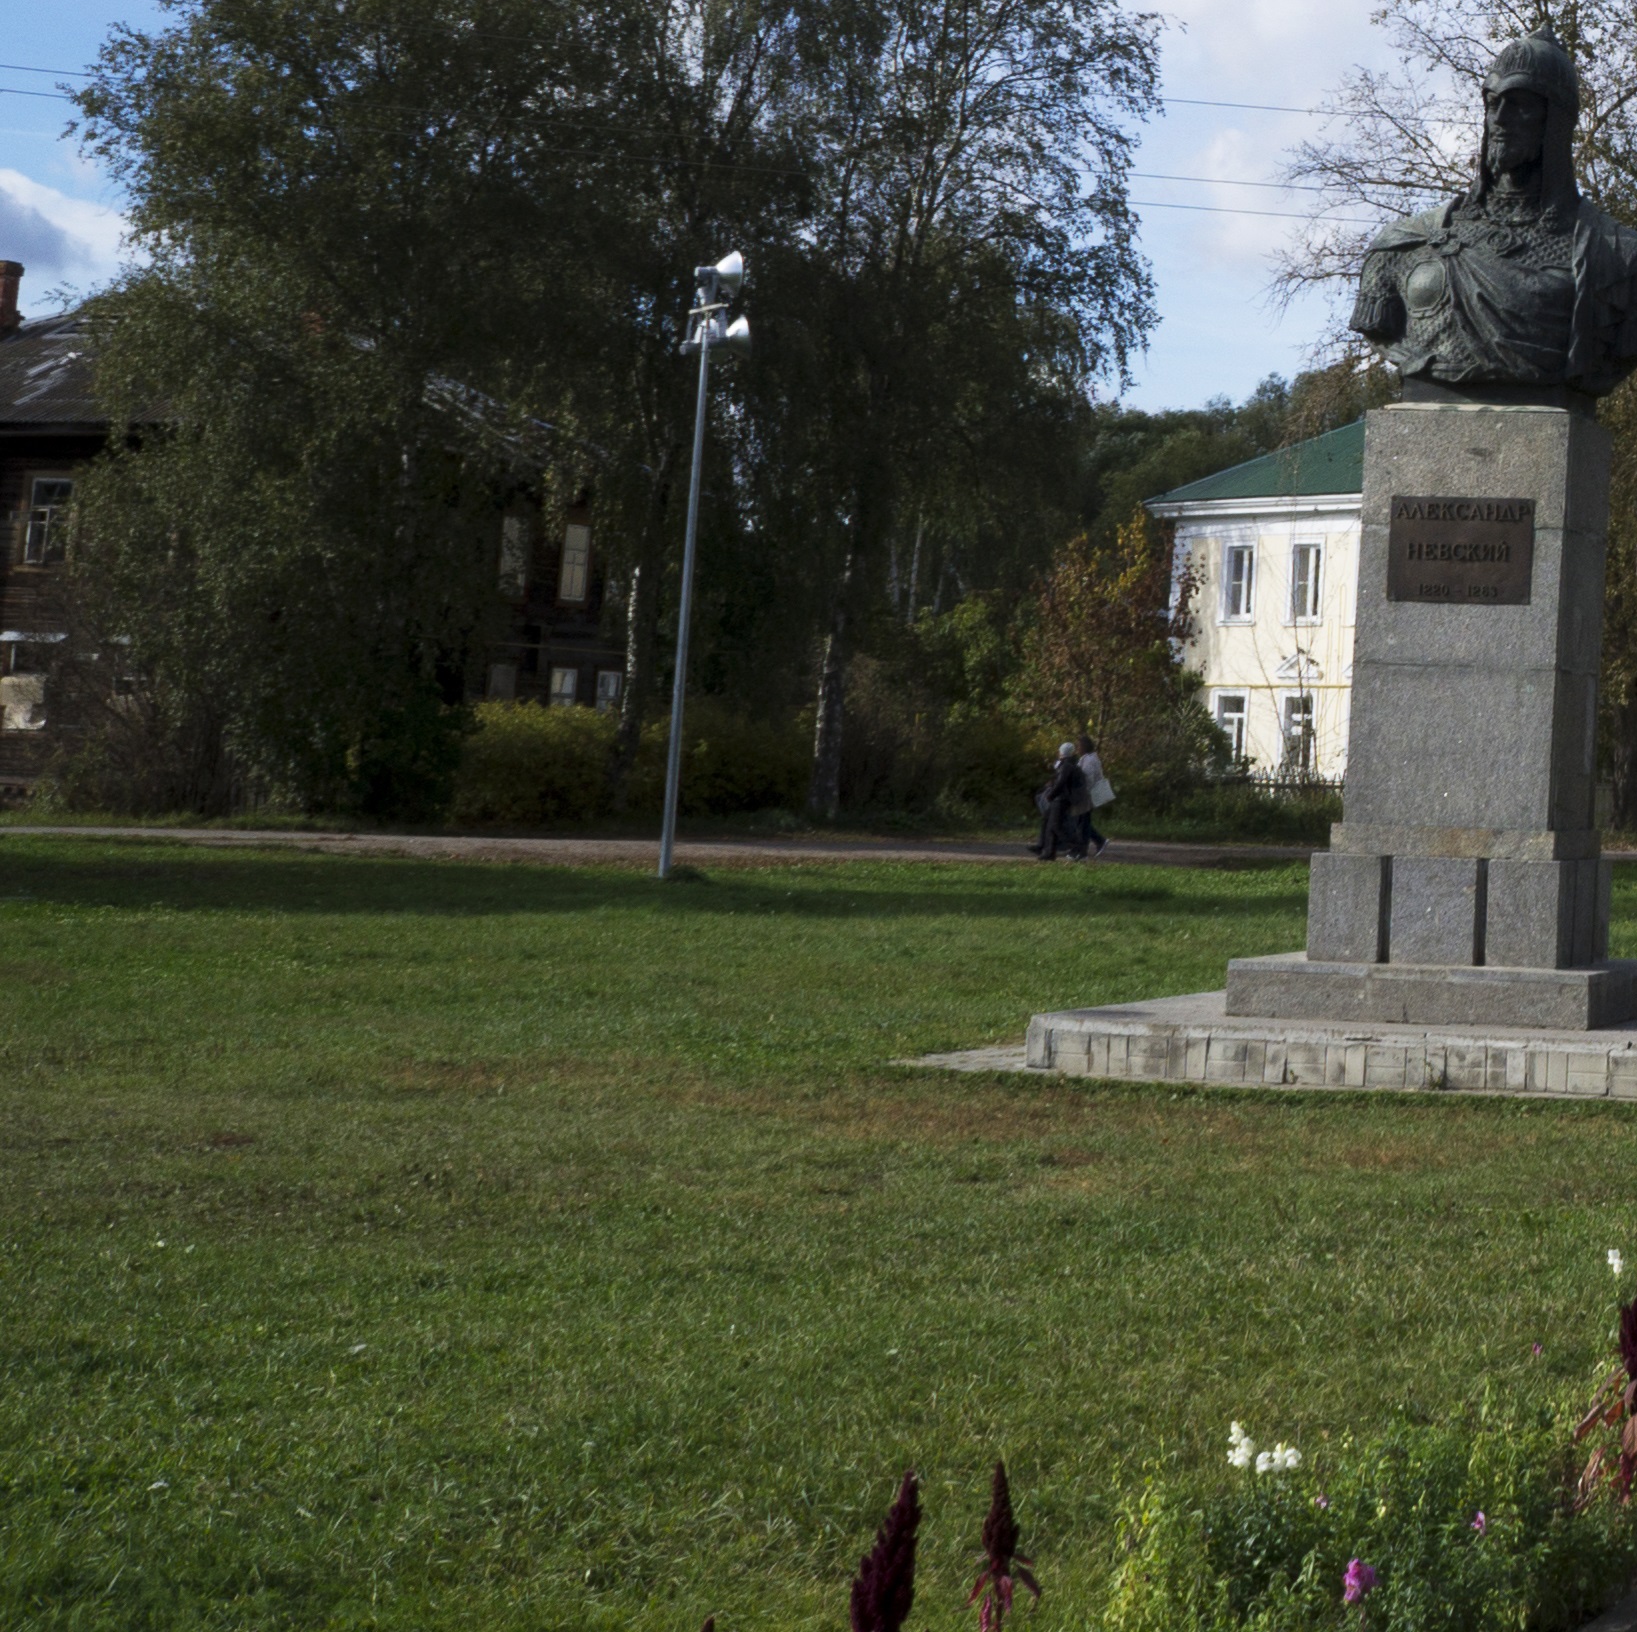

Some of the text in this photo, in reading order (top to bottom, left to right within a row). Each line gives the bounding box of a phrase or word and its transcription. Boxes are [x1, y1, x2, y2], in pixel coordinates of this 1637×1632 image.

[1397, 502, 1532, 522] АЛЕКСАНДР
[1407, 541, 1511, 563] НЕВСКИЙ
[1418, 583, 1450, 596] 1220
[1467, 585, 1499, 598] 1263
